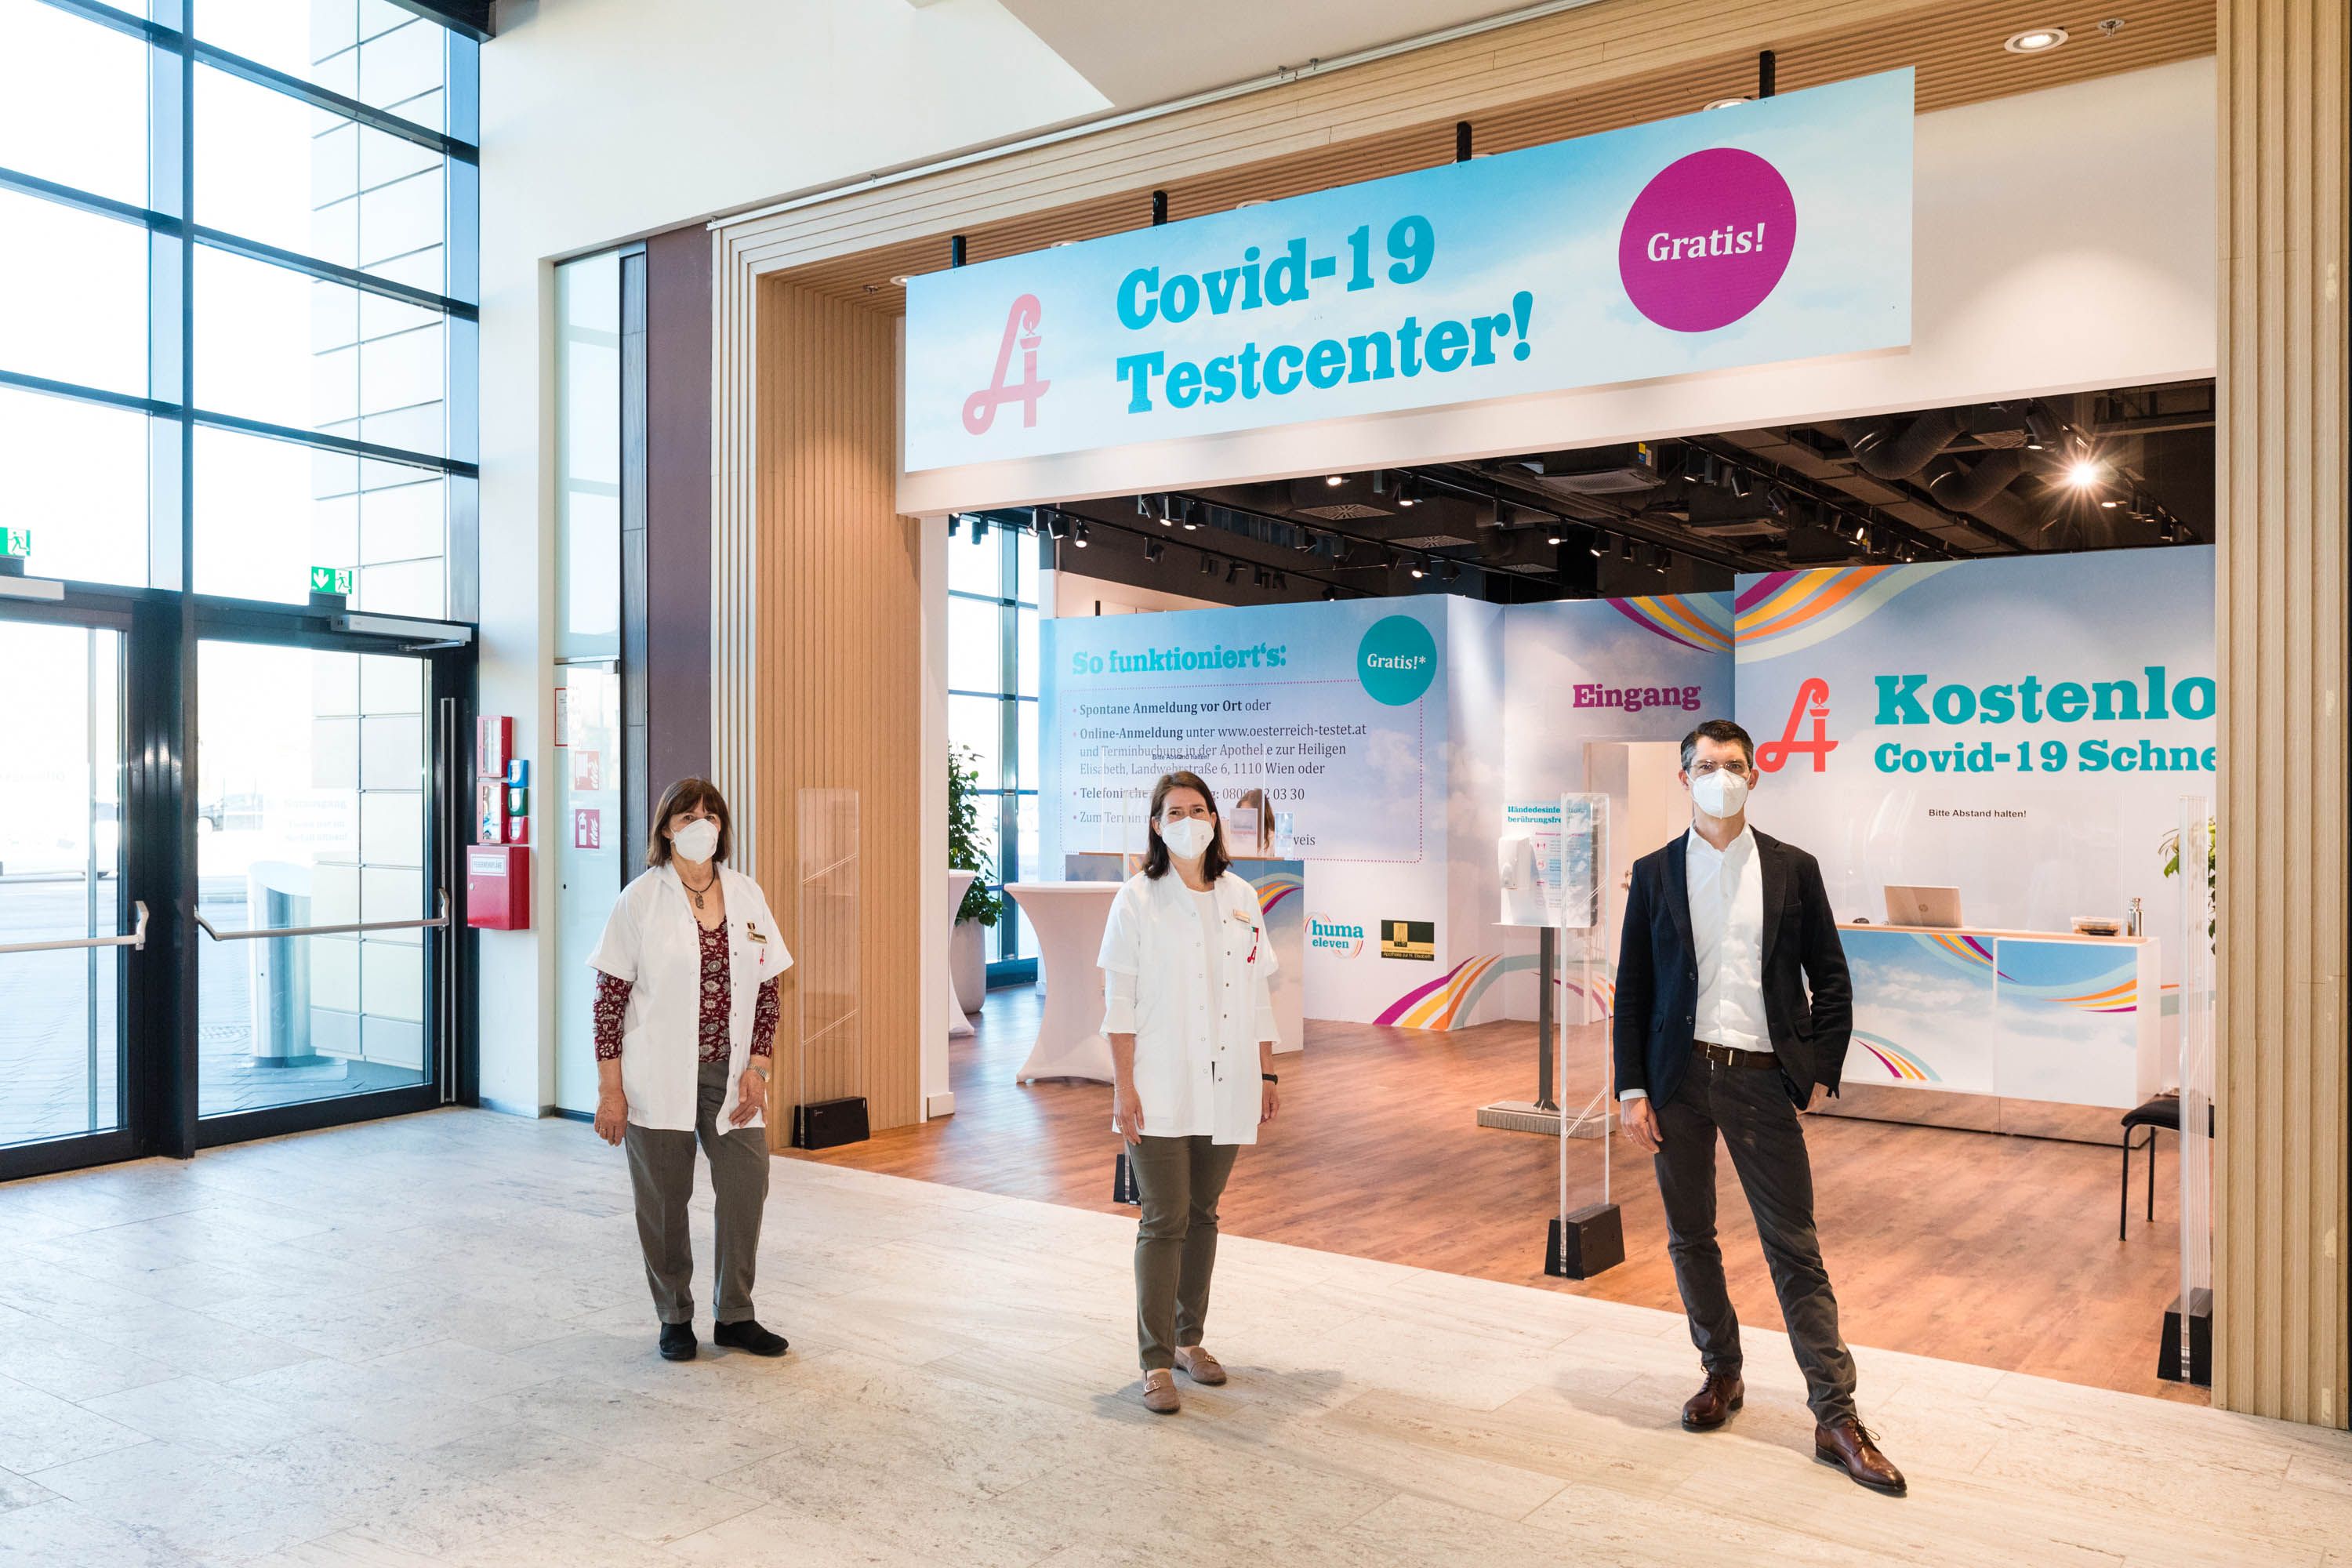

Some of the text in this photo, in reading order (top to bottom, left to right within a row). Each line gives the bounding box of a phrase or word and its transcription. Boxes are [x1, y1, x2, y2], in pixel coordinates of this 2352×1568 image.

[1647, 223, 1765, 262] Gratis!
[1116, 215, 1436, 330] Covid-19
[1116, 290, 1534, 414] Testcenter!
[1072, 652, 1103, 675] So
[1573, 684, 1701, 712] Eingang
[1875, 666, 2216, 725] Kostenlo
[1080, 699, 1272, 717] Spontane Anmeldung vor Ort oder
[1080, 724, 1367, 741] Online-Anmeldung unter www.oesterreich-testet.at
[1080, 746, 1098, 757] und
[1102, 745, 1182, 759] Terminbuchung
[1185, 745, 1196, 756] in
[1198, 744, 1217, 756] der
[1276, 746, 1294, 755] zur
[1298, 743, 1346, 758] Heiligen
[1875, 739, 2216, 773] Covid-19 Schne
[1080, 761, 1325, 776] Elisabeth, Landwehrstraße 6, 1110 Wien oder
[1080, 787, 1149, 799] Telefoniche
[1273, 788, 1287, 800] 03
[1290, 788, 1305, 800] 30
[1080, 811, 1102, 822] Zum
[1312, 920, 1364, 938] huma
[1312, 937, 1349, 949] eleven
